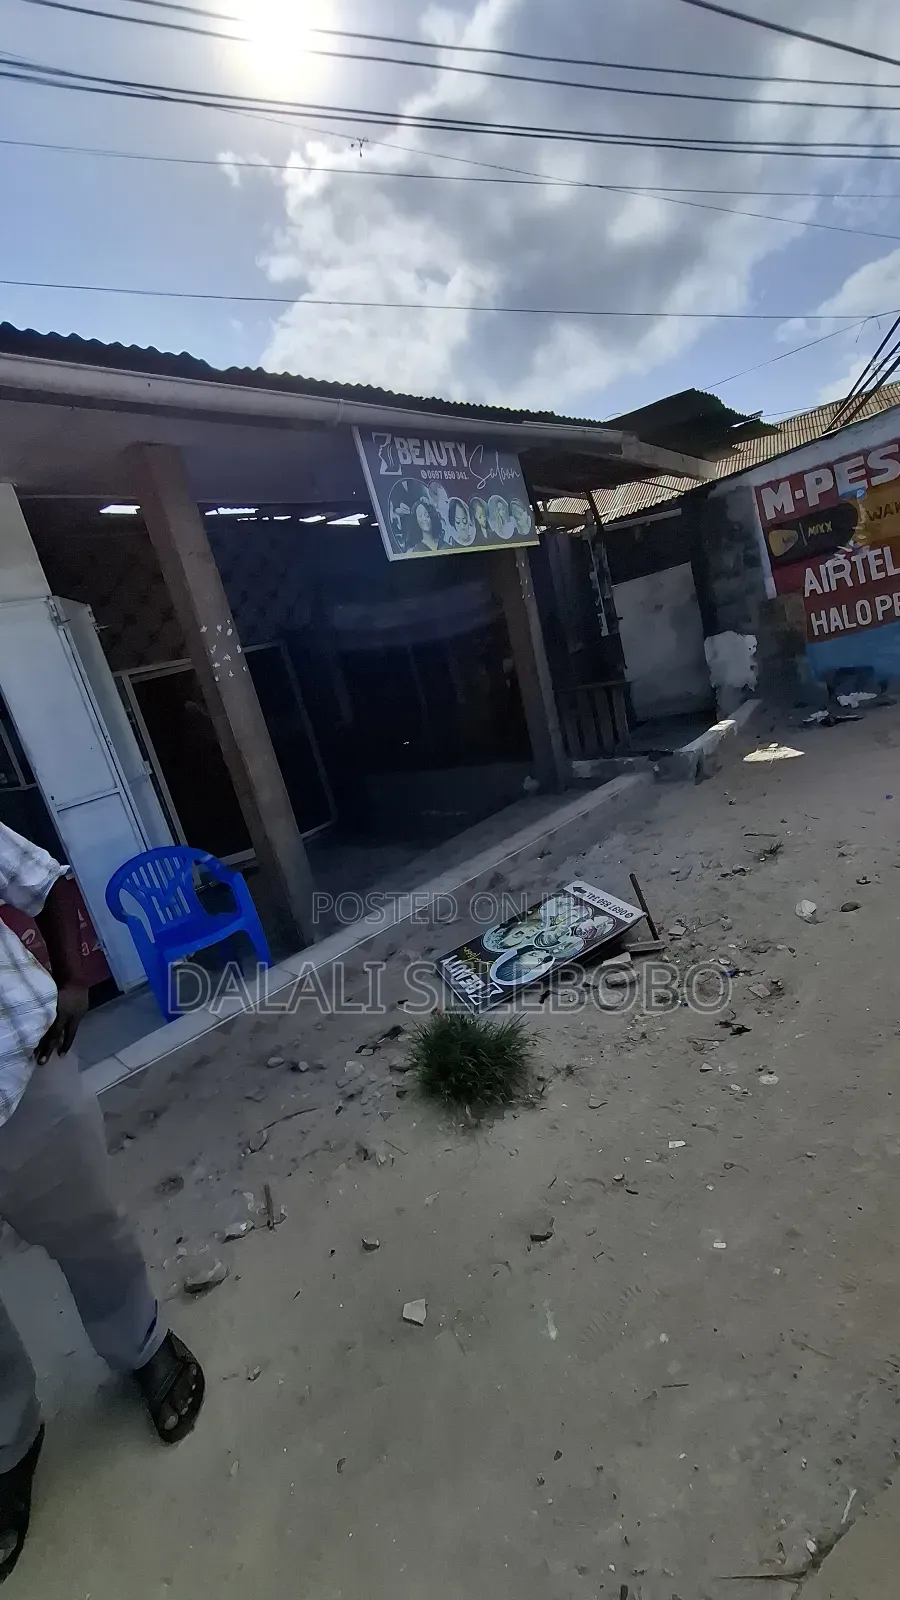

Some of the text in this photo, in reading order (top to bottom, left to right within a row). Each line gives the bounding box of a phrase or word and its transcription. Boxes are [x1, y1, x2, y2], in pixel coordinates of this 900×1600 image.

[393, 437, 469, 468] BEAUTY
[427, 470, 443, 480] 0697
[443, 470, 456, 480] 850
[807, 520, 833, 539] MIXX
[804, 546, 900, 598] AIRTEL
[596, 898, 612, 908] 850
[610, 904, 628, 916] 0697
[440, 954, 486, 995] BEAUTY
